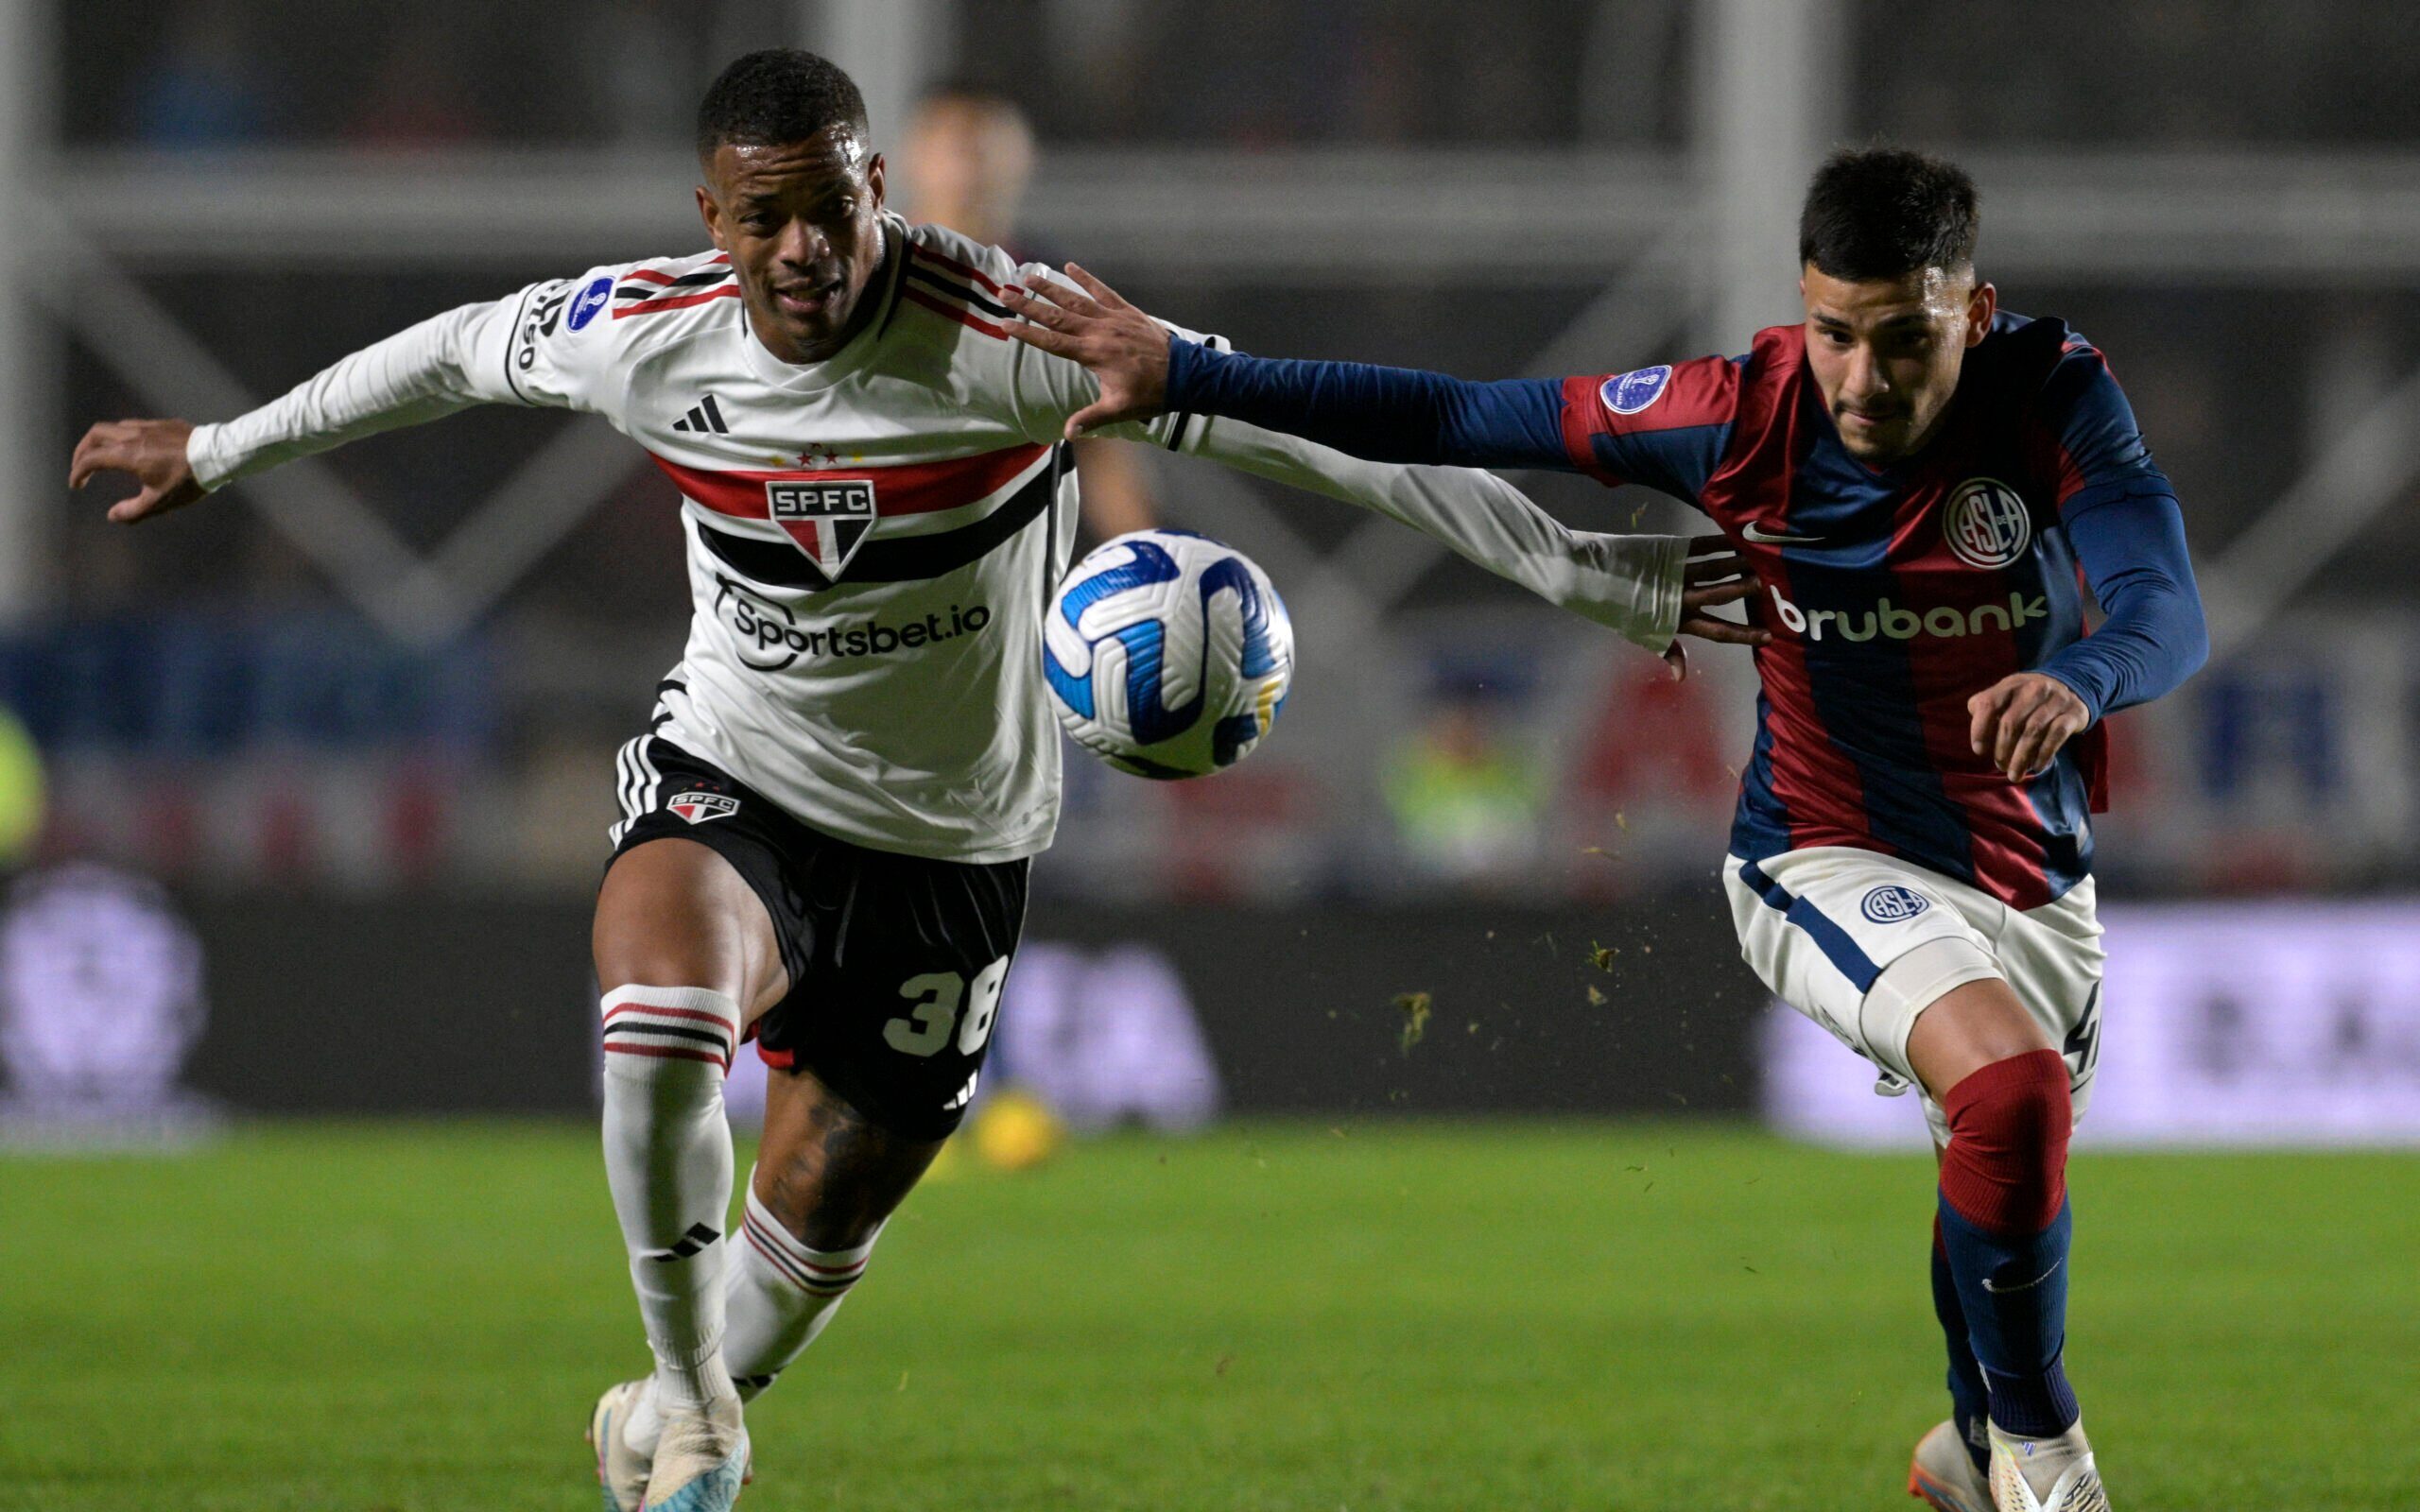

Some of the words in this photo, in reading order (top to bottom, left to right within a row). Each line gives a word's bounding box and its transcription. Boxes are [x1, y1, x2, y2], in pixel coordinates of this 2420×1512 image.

[775, 490, 868, 511] SPFC
[735, 598, 990, 657] Sportsbet.io
[1770, 584, 2047, 642] brubank
[675, 795, 734, 810] SPFC
[882, 954, 1009, 1057] 38
